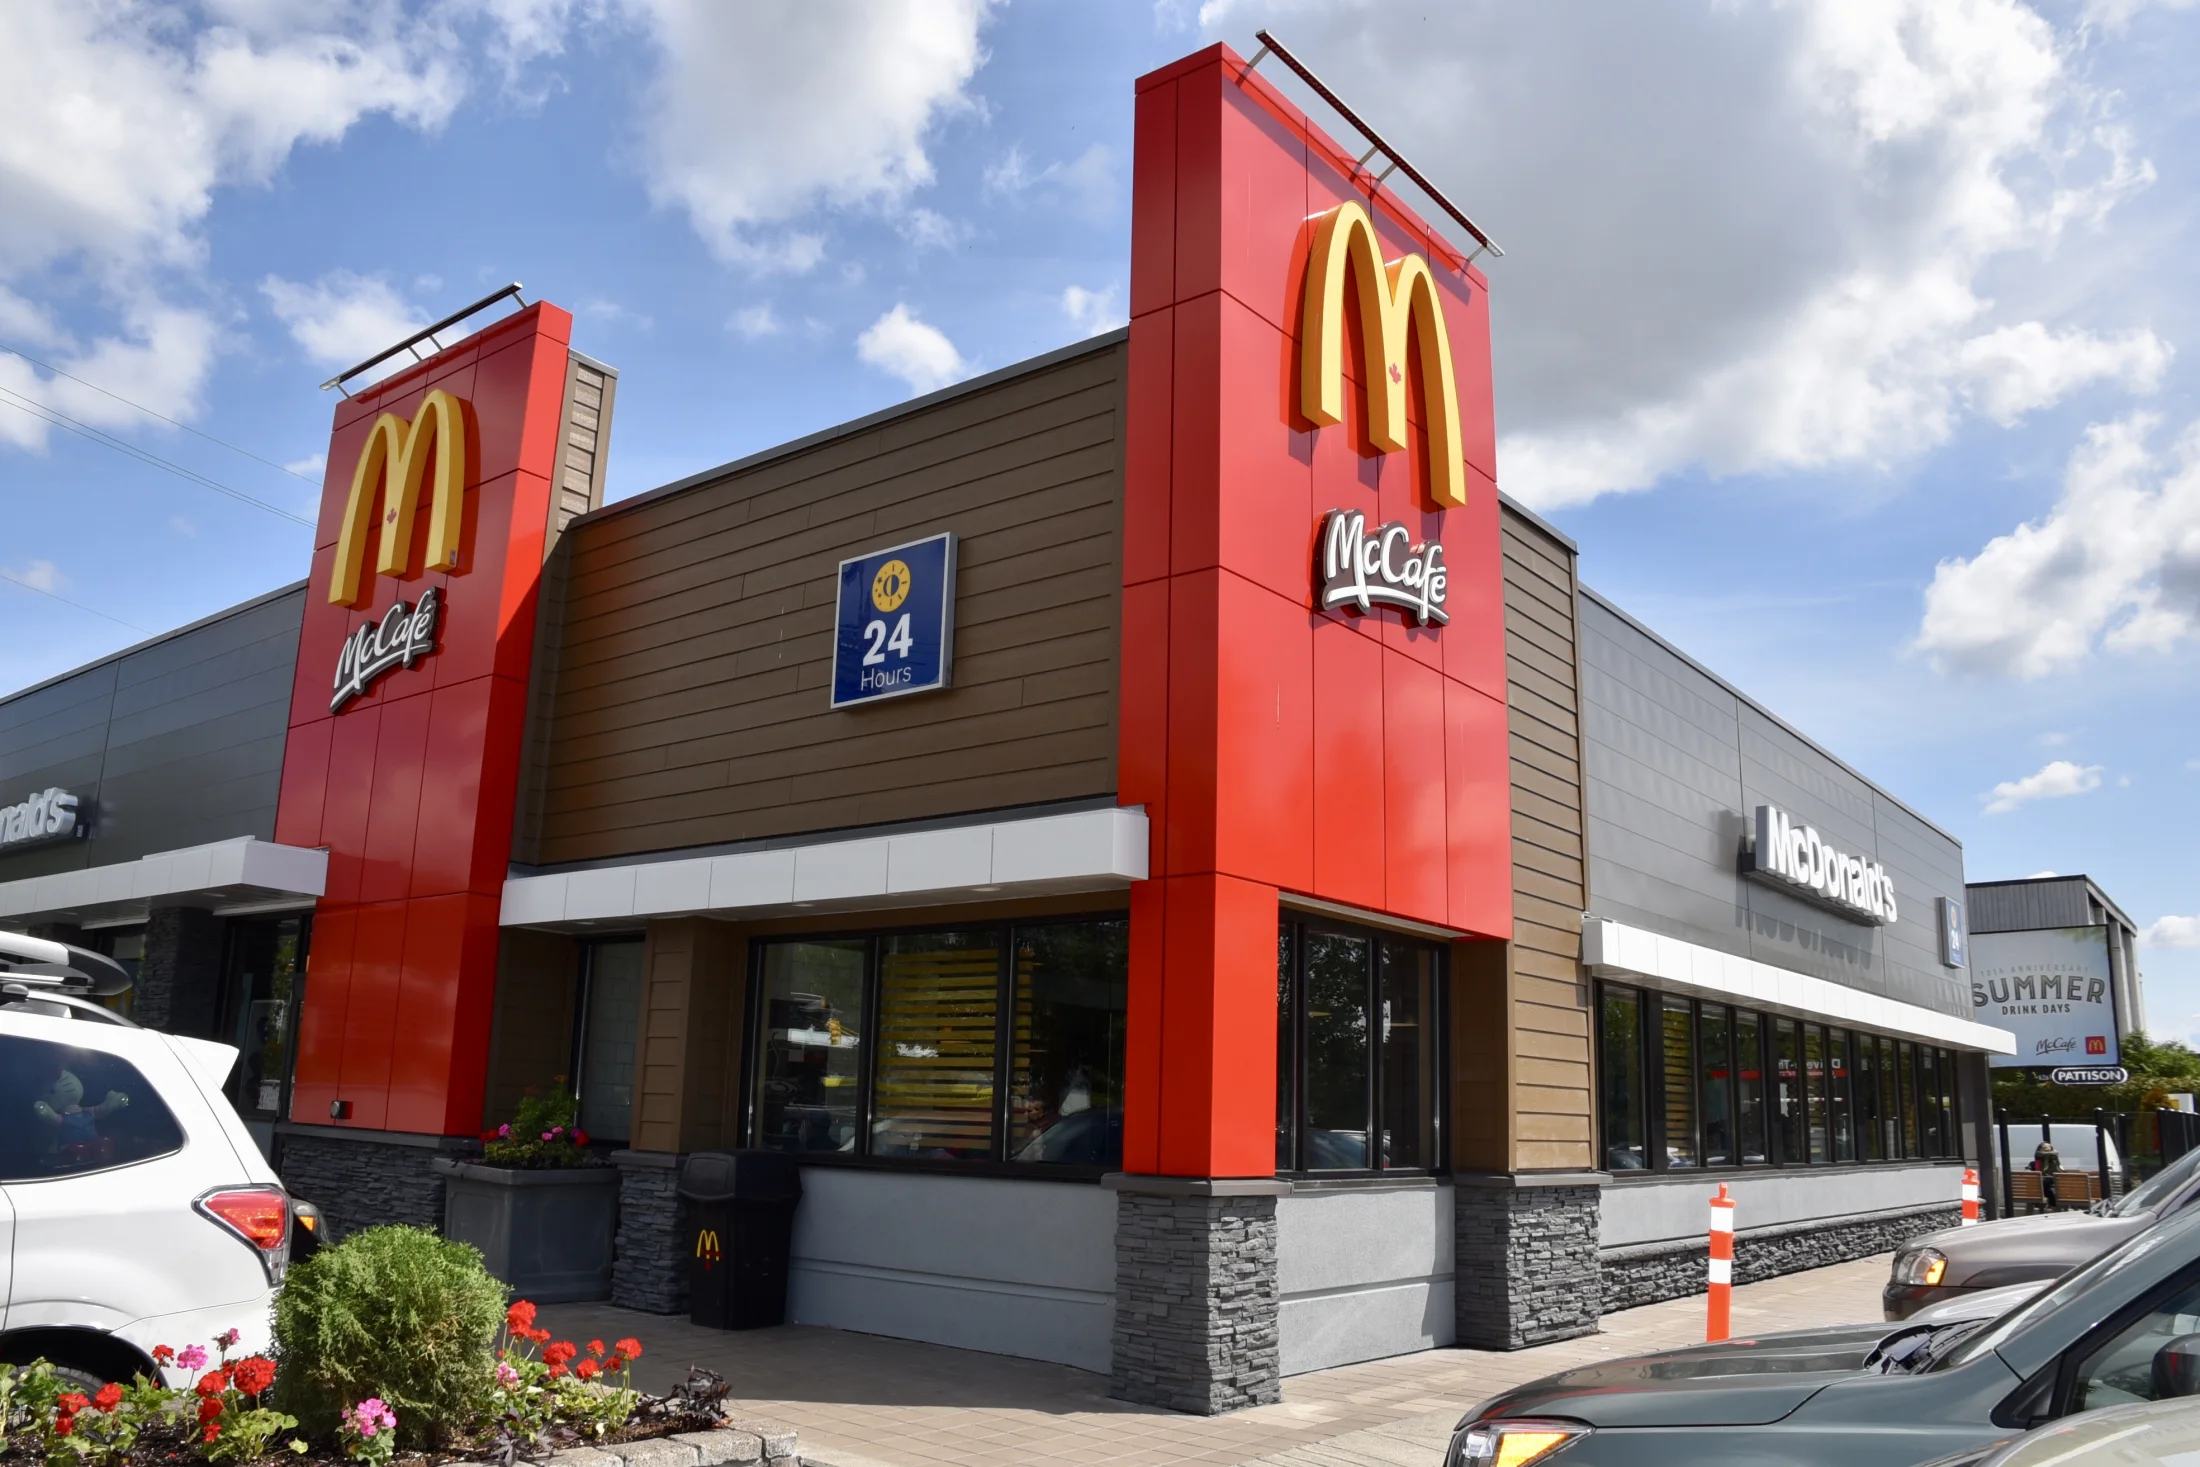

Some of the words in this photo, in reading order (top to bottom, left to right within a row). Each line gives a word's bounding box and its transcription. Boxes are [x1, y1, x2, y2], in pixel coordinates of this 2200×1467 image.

[1327, 513, 1449, 626] McCafé
[330, 589, 432, 700] McCafé
[863, 613, 914, 667] 24
[860, 666, 911, 691] Hours
[1765, 804, 1898, 923] McDonald's
[2011, 962, 2090, 974] ANNIVERSARY
[1972, 974, 2106, 1008] SUMMER
[2001, 1005, 2038, 1016] DRINK
[2042, 1003, 2071, 1014] DAYS
[2035, 1036, 2078, 1056] McCafé
[2057, 1070, 2121, 1081] PATTISON
